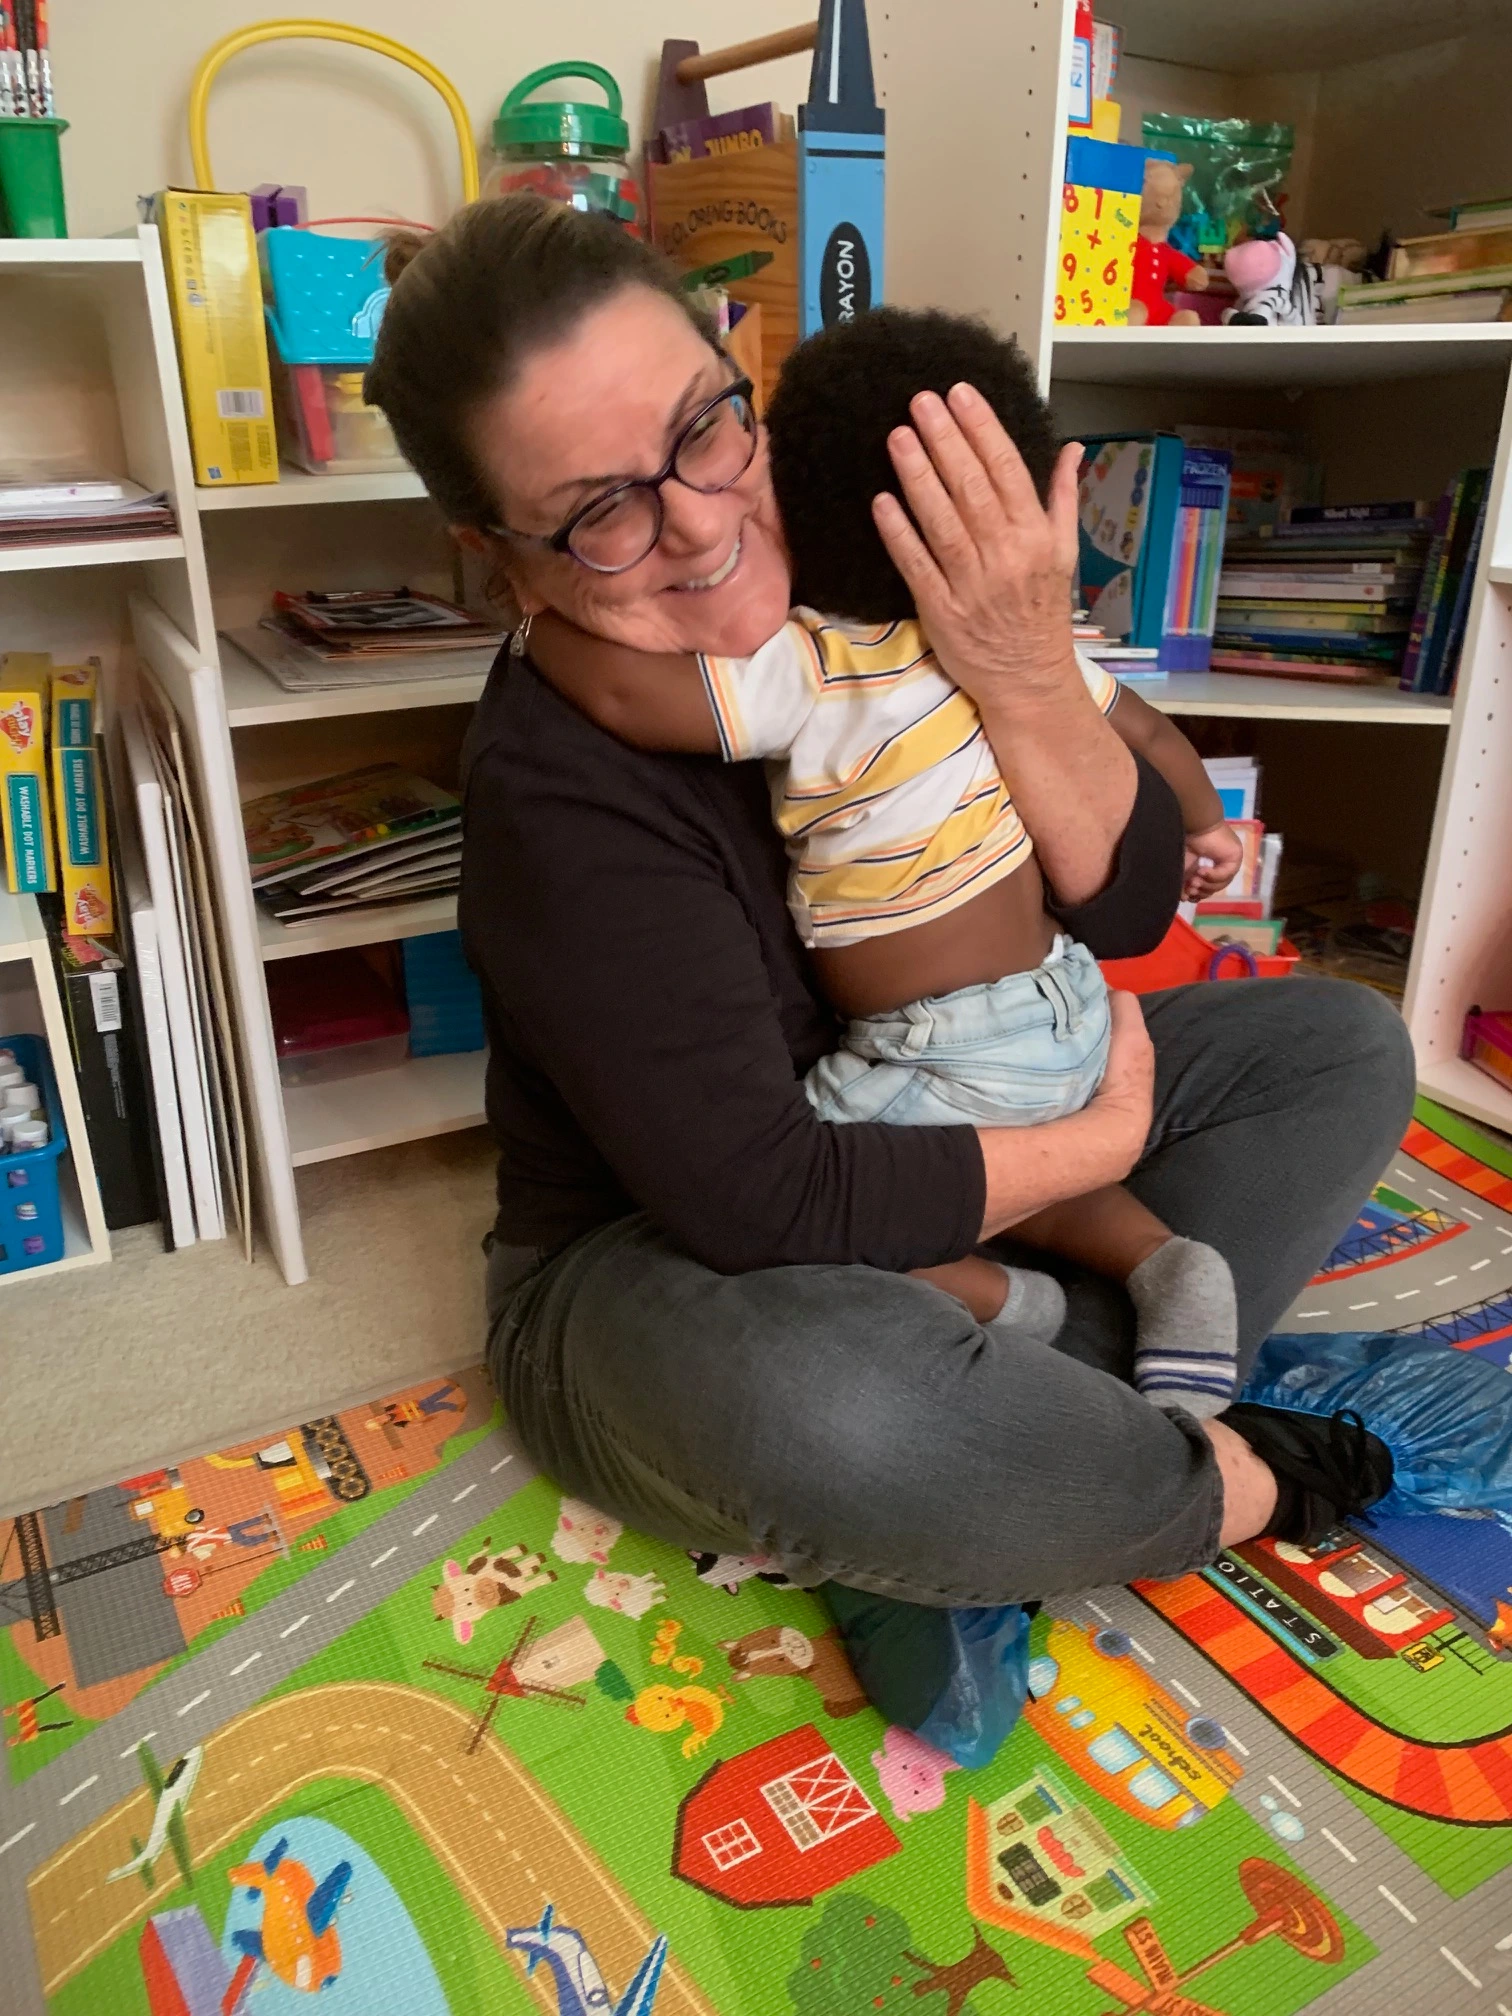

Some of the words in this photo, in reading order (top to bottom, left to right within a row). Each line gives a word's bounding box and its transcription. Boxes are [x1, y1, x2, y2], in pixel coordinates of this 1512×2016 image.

[72, 759, 85, 794] MARKERS
[19, 786, 32, 828] WASHABLE
[75, 797, 87, 812] DOT
[23, 832, 34, 846] DOT
[77, 815, 90, 855] WASHABLE
[25, 849, 37, 884] MARKERS
[1138, 1724, 1202, 1780] school
[1132, 1925, 1154, 1945] ST
[1144, 1943, 1174, 1985] MAIN
